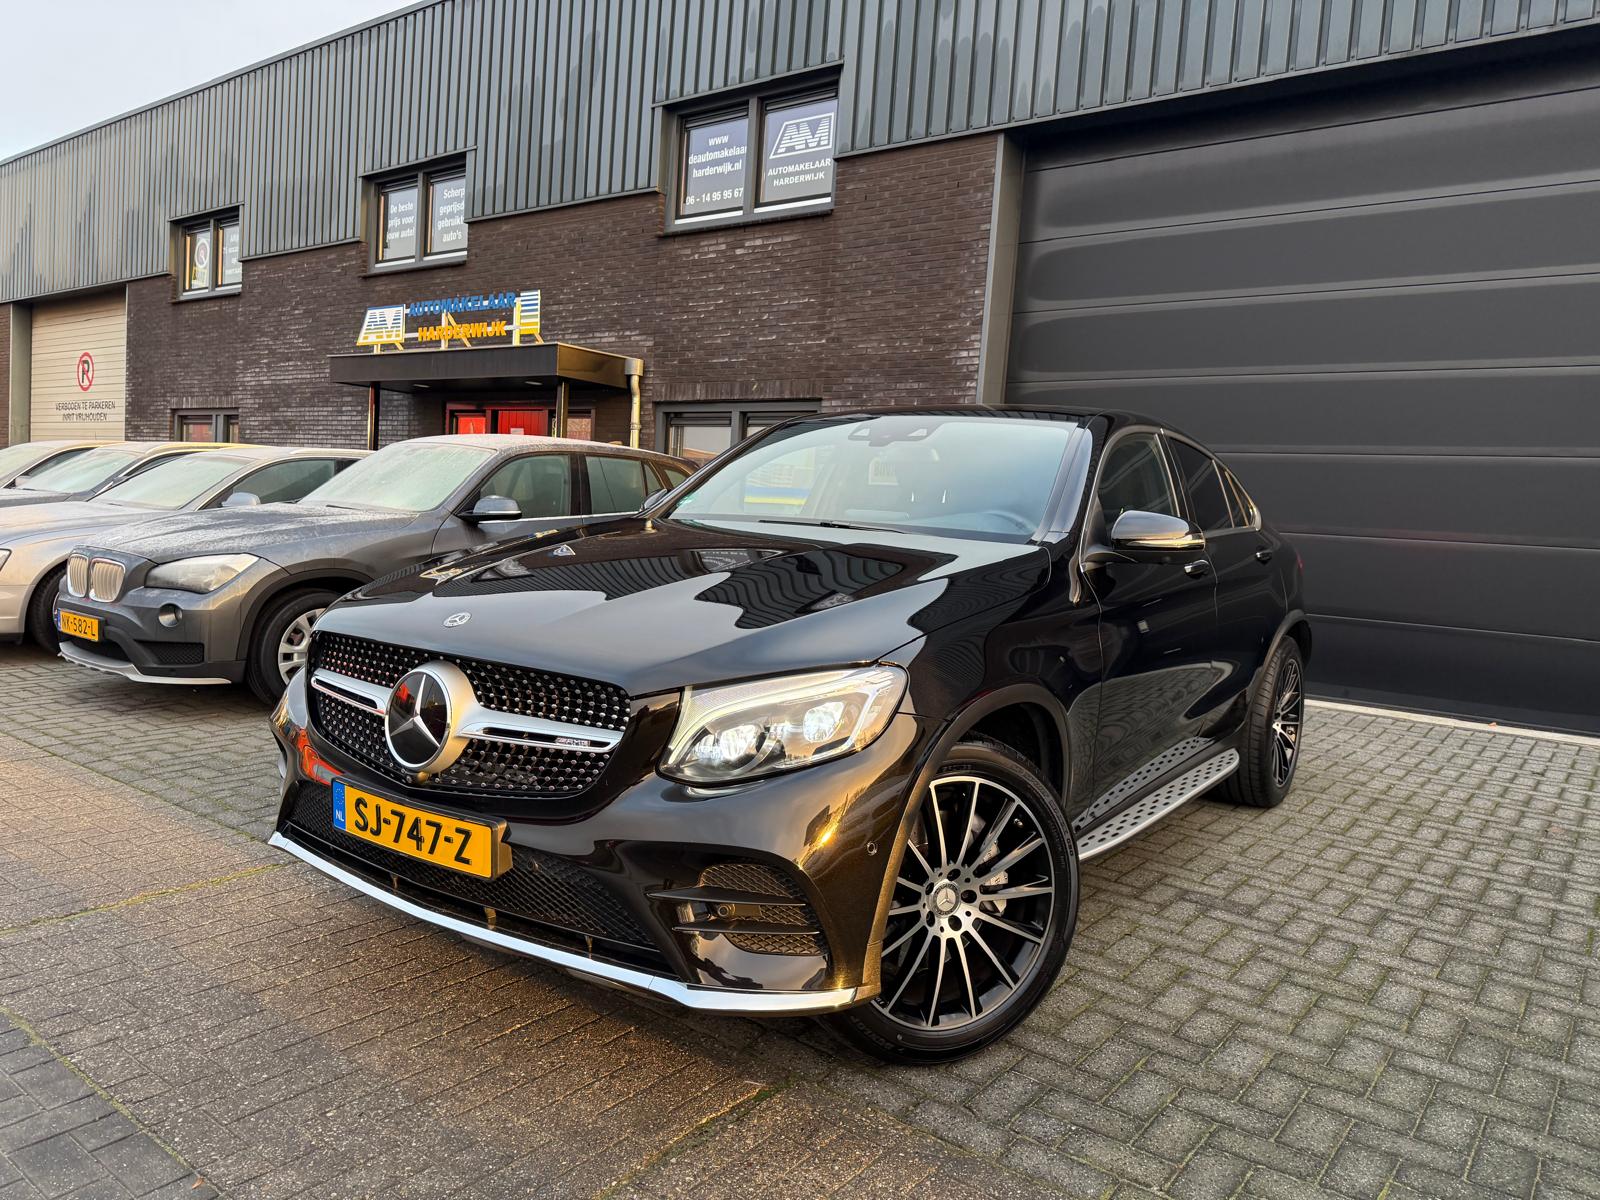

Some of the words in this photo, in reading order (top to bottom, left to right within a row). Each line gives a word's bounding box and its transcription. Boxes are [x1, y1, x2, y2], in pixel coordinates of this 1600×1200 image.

[708, 135, 729, 146] www
[692, 159, 742, 178] harderwijk.nl
[767, 158, 832, 177] AUTOMAKELAAR
[773, 171, 825, 187] HARDERWIJK
[686, 196, 695, 205] 06
[702, 193, 711, 203] 14
[712, 191, 721, 201] 95
[723, 189, 732, 200] 95
[734, 187, 743, 198] 67
[402, 215, 415, 225] voor
[442, 229, 463, 242] auto's
[408, 292, 516, 317] AUTOMAKELAAR
[417, 320, 507, 342] HARDERWIJK
[89, 400, 116, 410] PARKEREN
[335, 809, 345, 822] NL
[354, 797, 472, 865] SJ-747-Z
